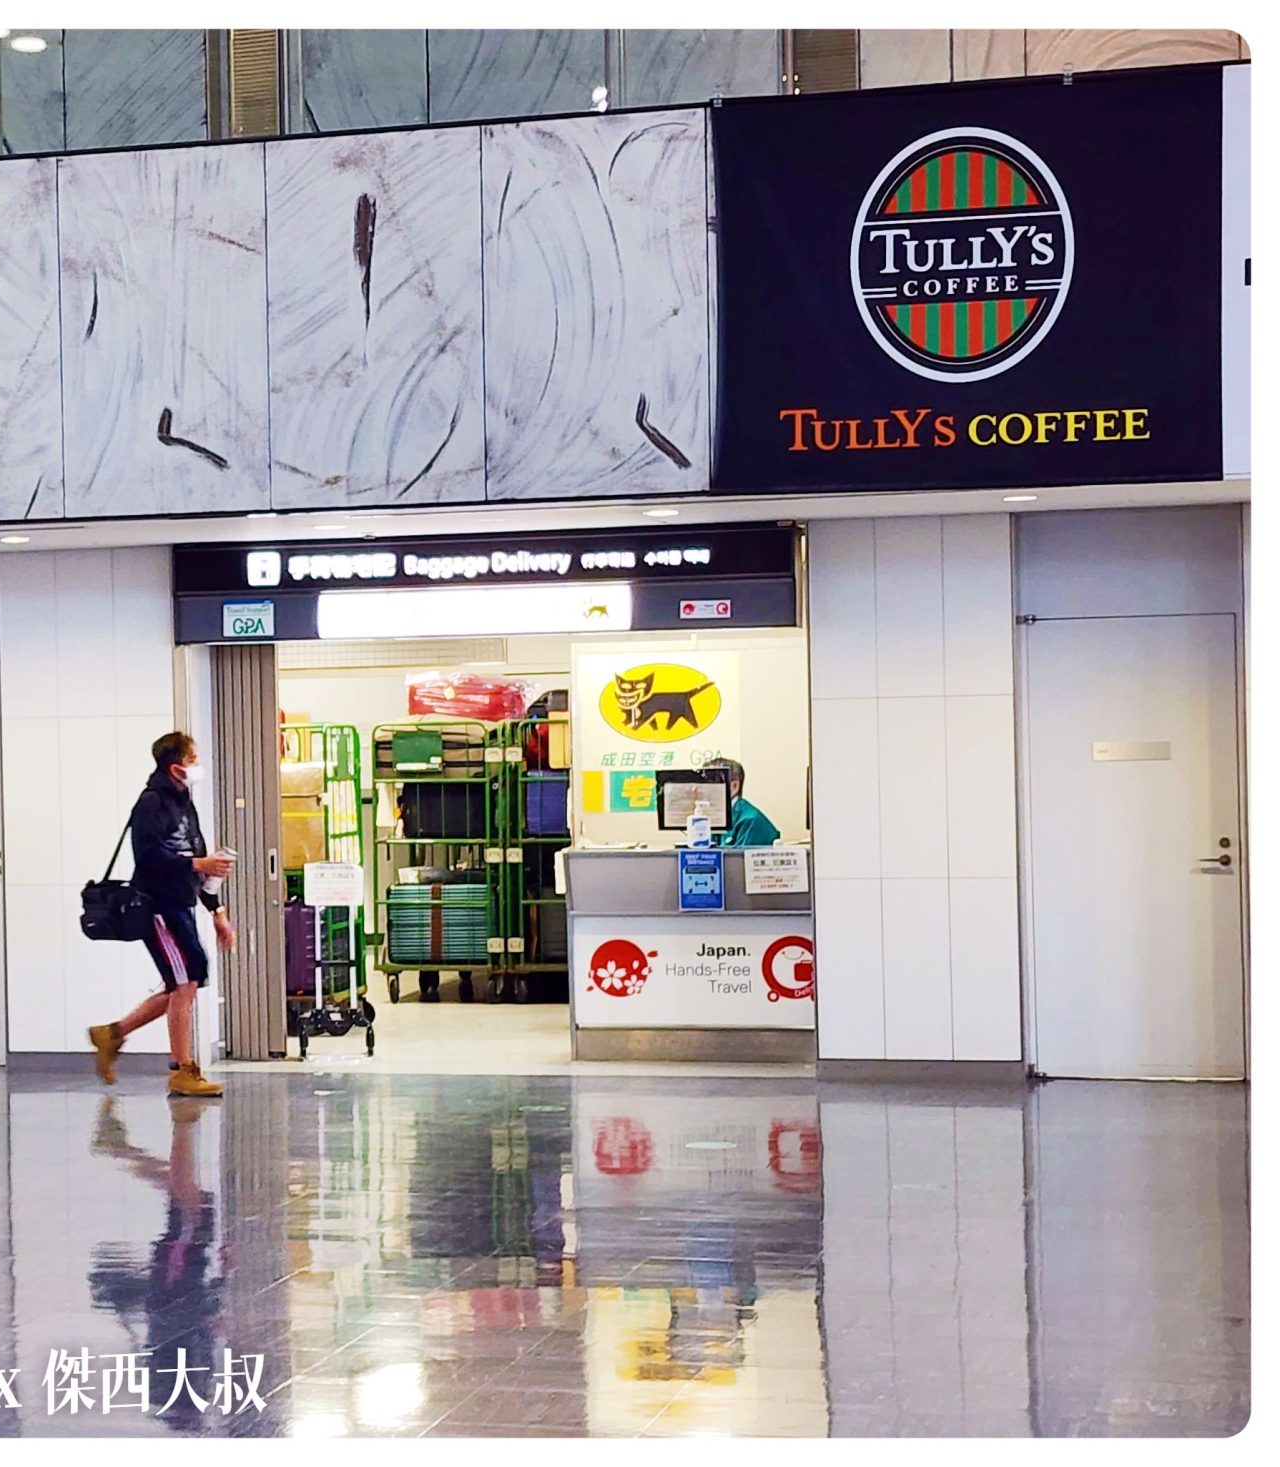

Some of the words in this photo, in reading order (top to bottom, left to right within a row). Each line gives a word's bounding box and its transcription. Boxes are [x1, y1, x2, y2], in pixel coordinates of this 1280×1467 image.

[869, 225, 1055, 274] TULLY'S
[902, 275, 1021, 297] COFFEE
[968, 408, 1151, 446] COFFEE
[404, 553, 489, 580] Baggage
[491, 549, 572, 575] Delivery
[232, 617, 266, 635] GPA
[599, 750, 676, 768] 成田空港
[621, 775, 658, 808] 宅
[696, 943, 751, 959] Japan.
[665, 962, 751, 977] Hands-Free
[708, 980, 752, 994] Travel
